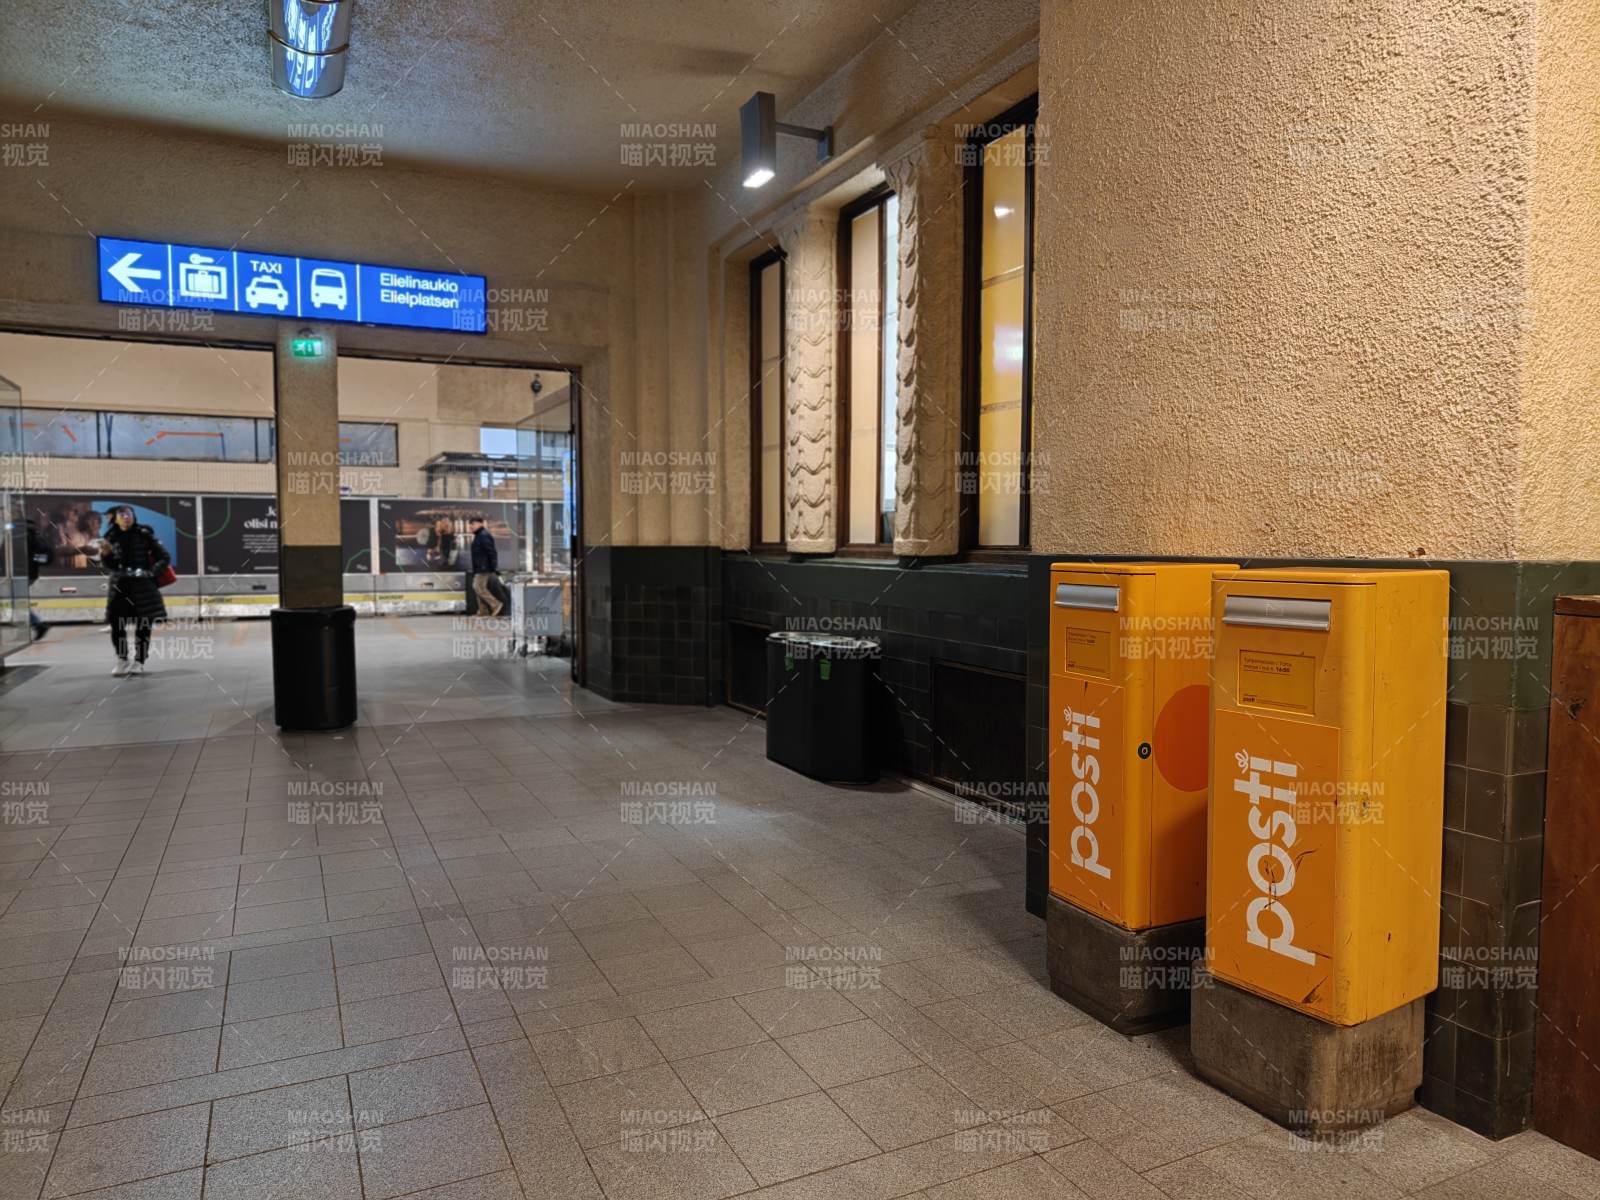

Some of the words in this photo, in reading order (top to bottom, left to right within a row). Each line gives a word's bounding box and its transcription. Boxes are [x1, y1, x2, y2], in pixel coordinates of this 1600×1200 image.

[250, 260, 283, 274] TAXI
[380, 273, 459, 292] Elielinaukio
[380, 289, 459, 309] Elielplatsen
[1063, 706, 1111, 880] posti
[1233, 749, 1316, 966] posti
